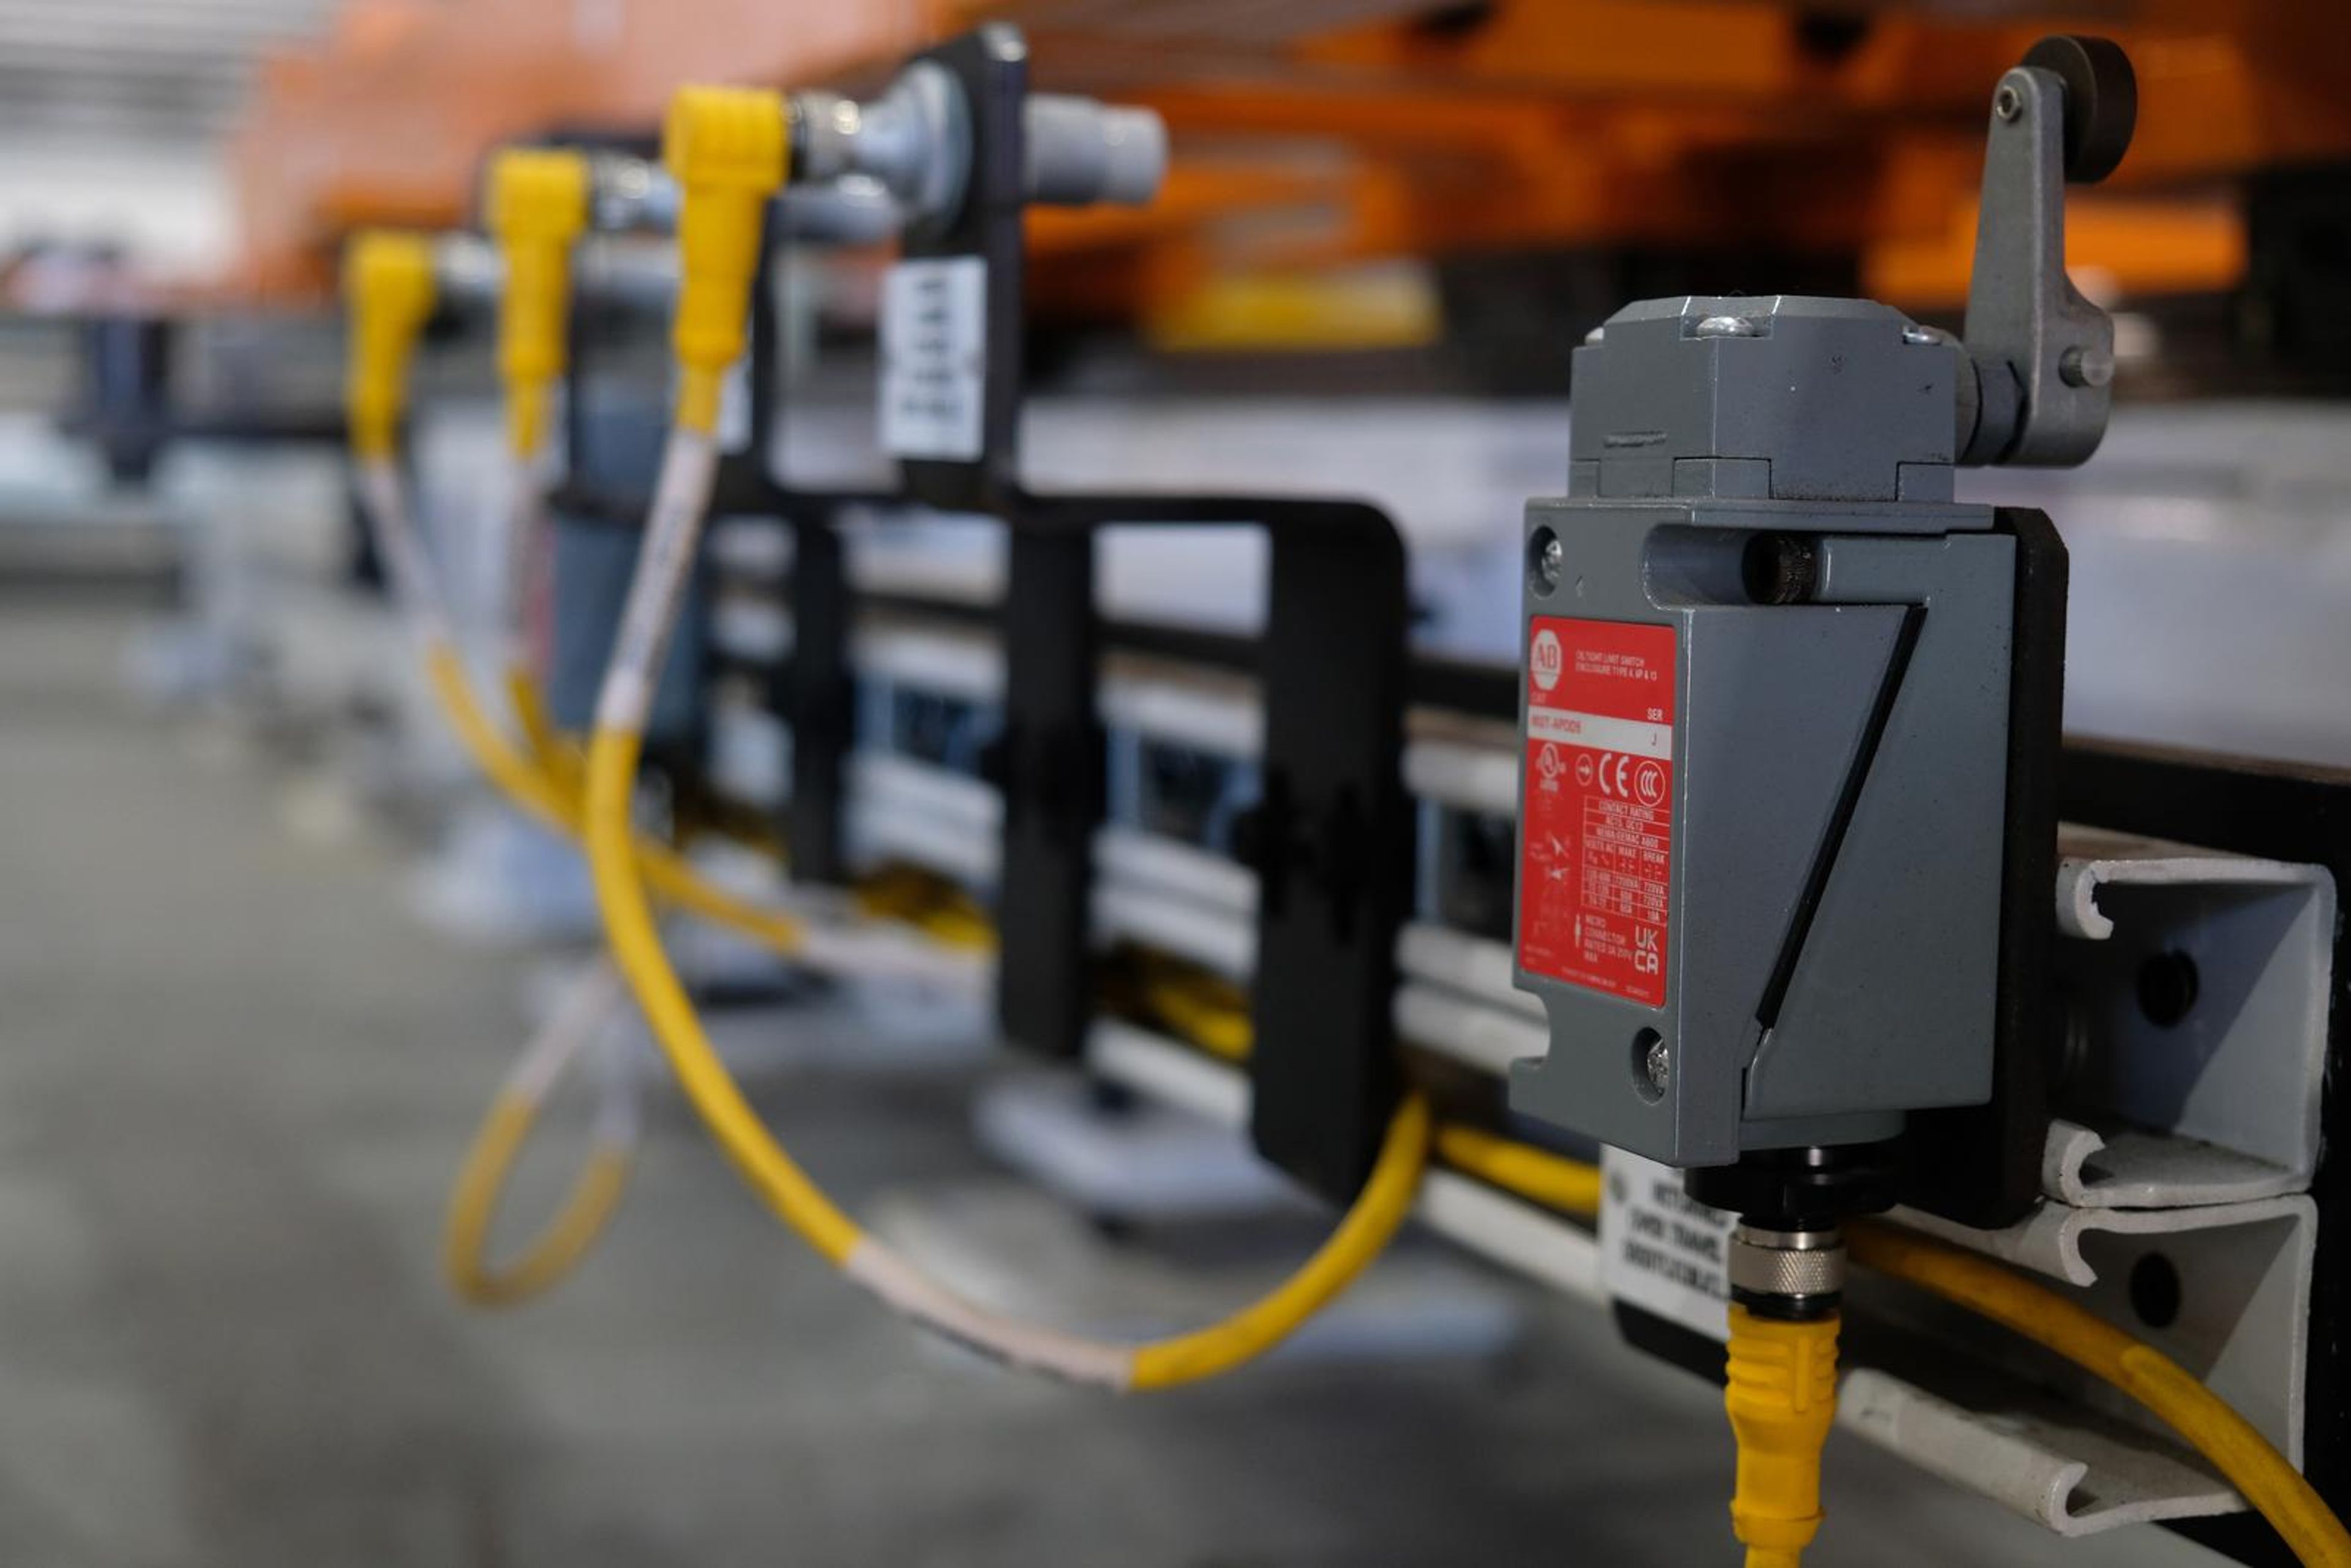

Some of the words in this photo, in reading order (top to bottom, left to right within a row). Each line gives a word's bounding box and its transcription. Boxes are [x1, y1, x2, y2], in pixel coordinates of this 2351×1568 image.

[1535, 643, 1558, 670] AB
[1646, 707, 1664, 721] SER
[1651, 732, 1657, 746] J
[1643, 850, 1665, 864] BREAK
[1635, 925, 1659, 953] UK
[1633, 948, 1659, 976] CA
